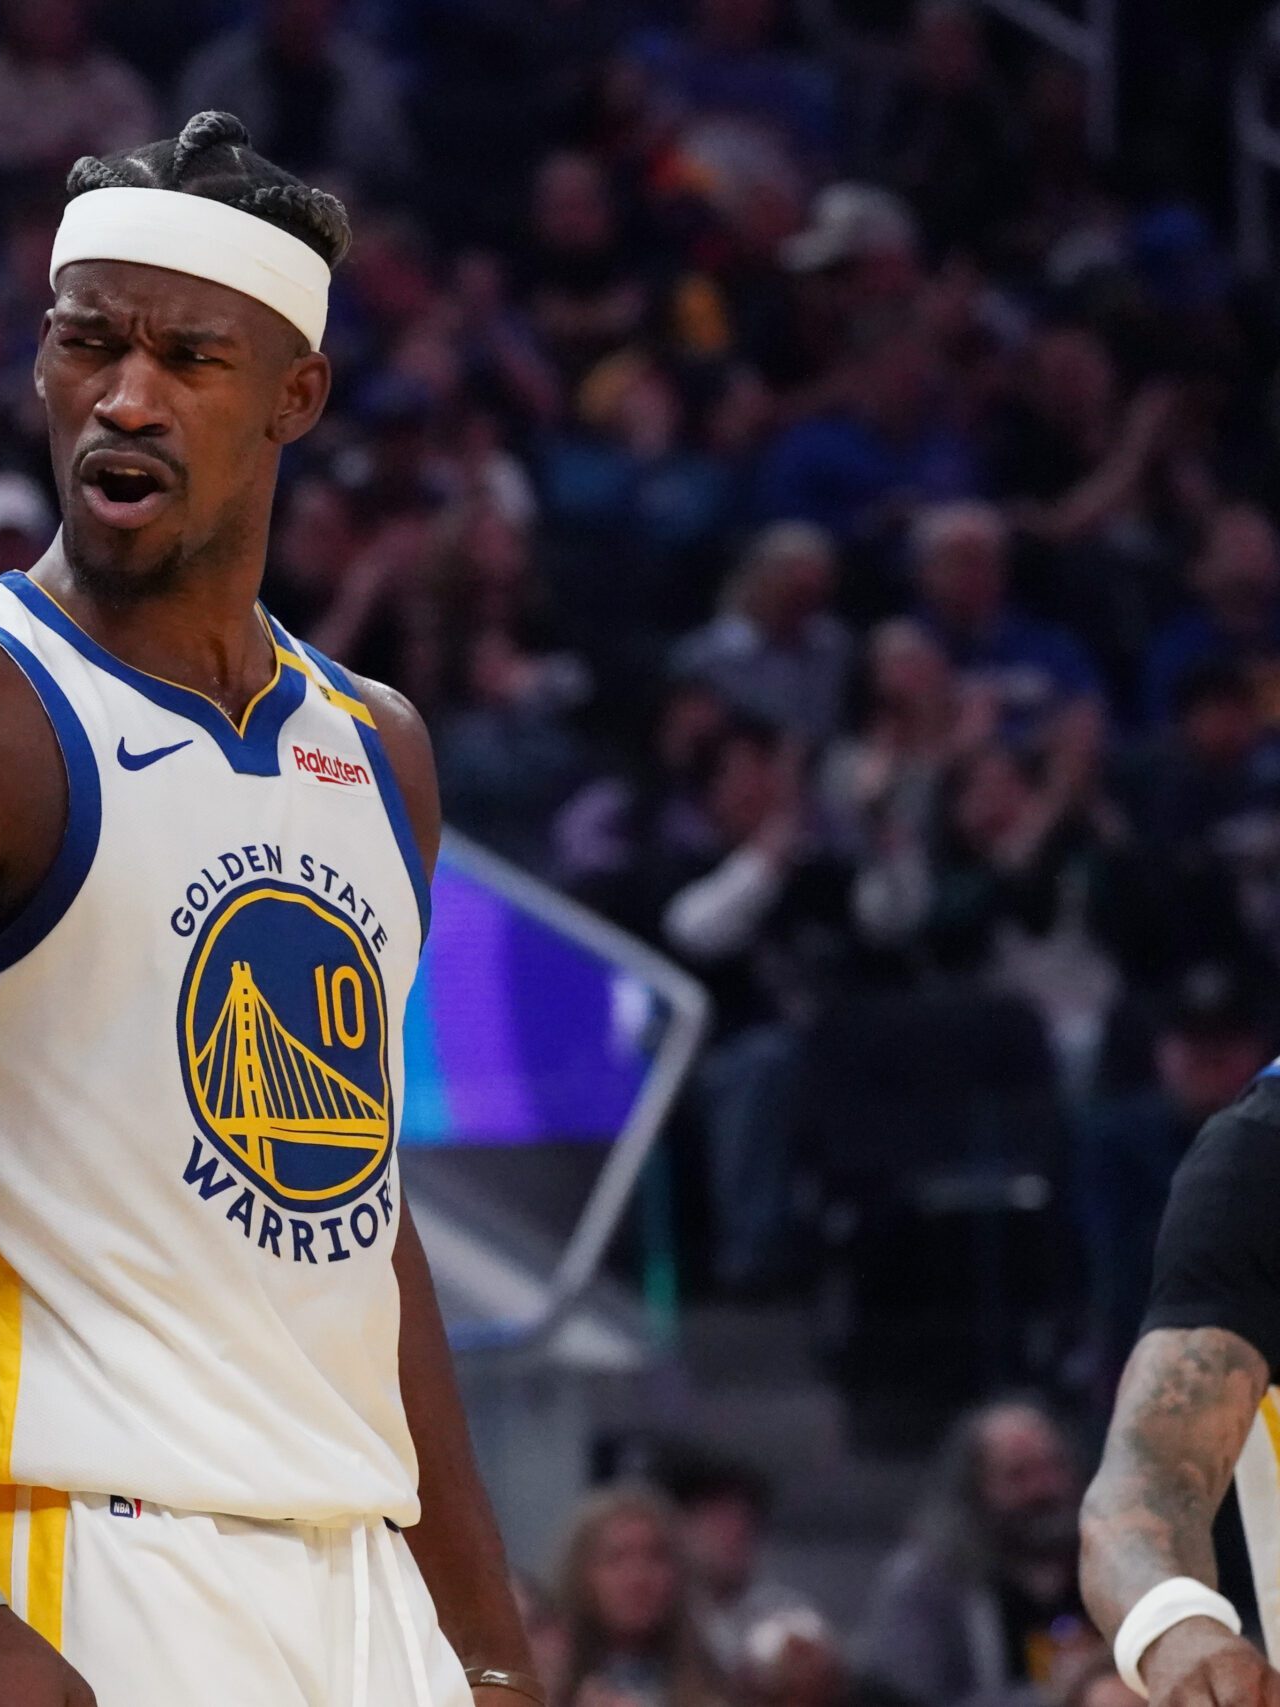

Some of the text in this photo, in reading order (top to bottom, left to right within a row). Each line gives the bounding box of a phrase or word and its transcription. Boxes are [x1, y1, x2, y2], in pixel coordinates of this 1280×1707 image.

[292, 745, 371, 787] Rakuten
[170, 843, 388, 953] GOLDEN STATE
[314, 964, 366, 1050] 10
[182, 1135, 394, 1265] WARRIOR
[113, 1501, 131, 1515] NBA
